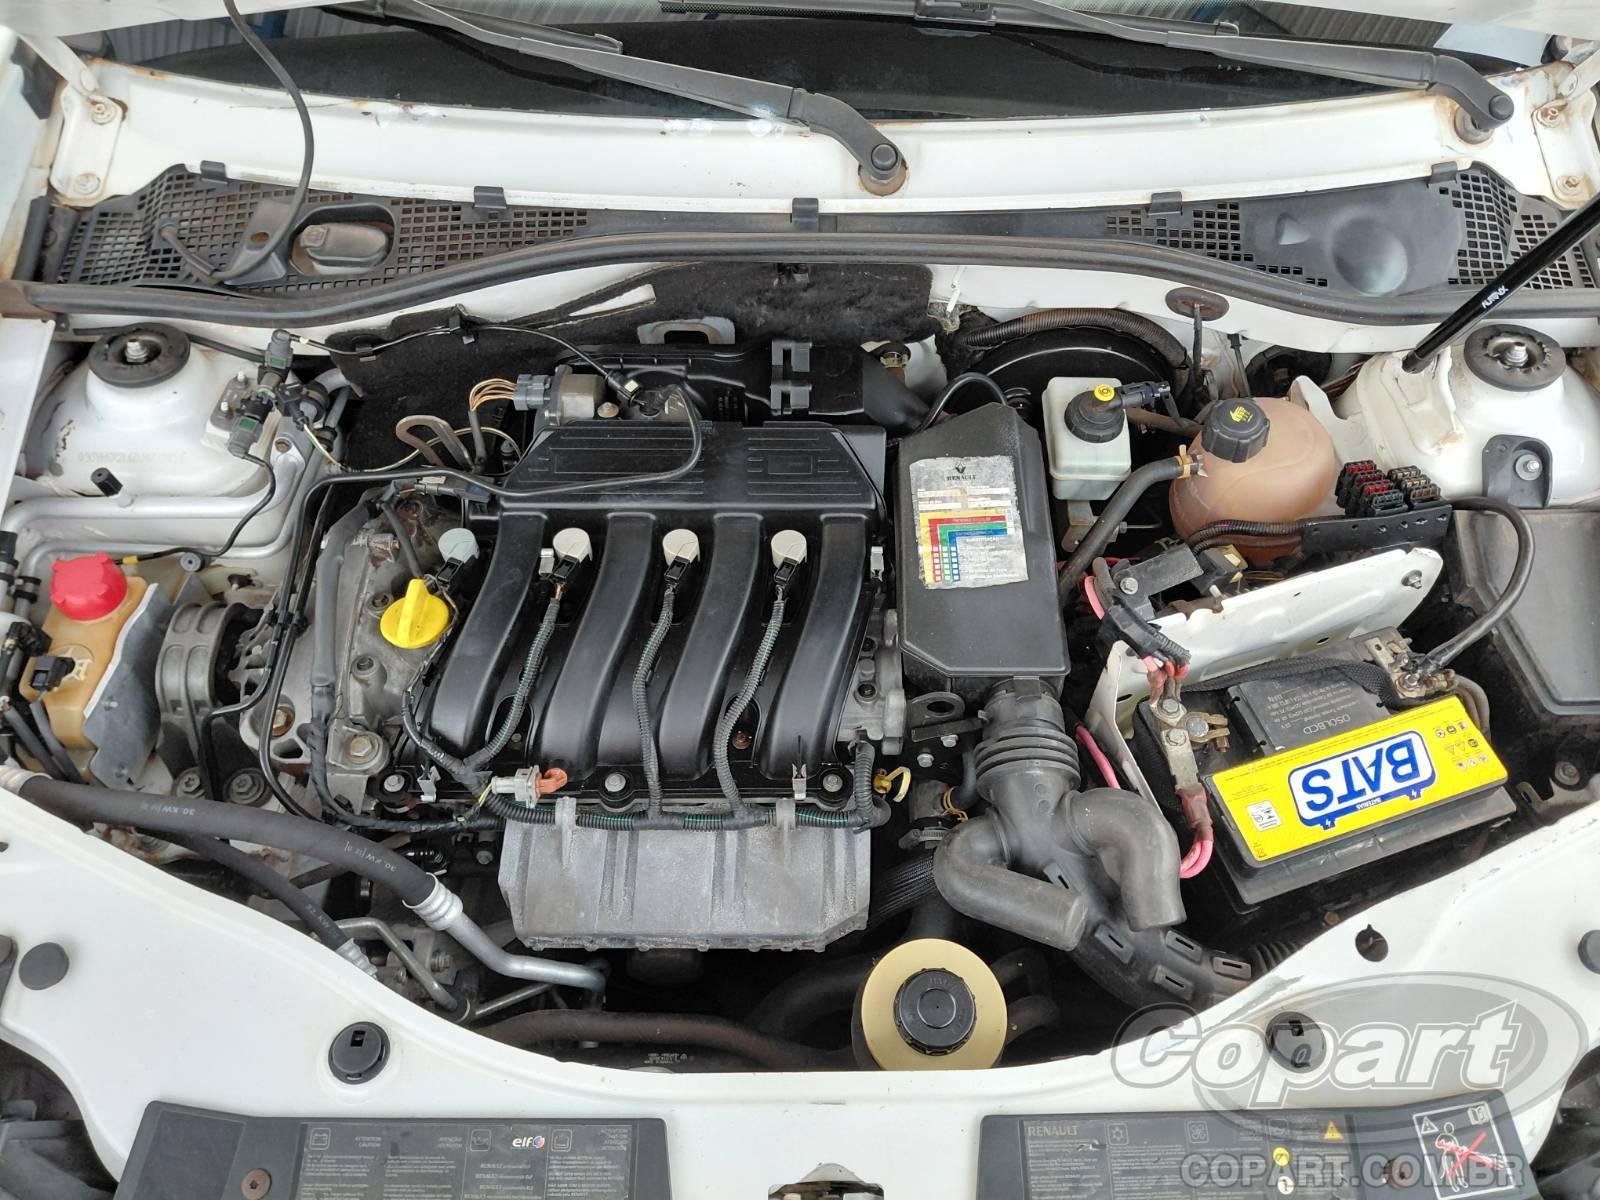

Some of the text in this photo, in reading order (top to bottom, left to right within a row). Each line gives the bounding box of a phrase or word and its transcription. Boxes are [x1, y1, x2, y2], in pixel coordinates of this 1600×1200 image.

[1301, 738, 1421, 812] BATS
[1027, 1125, 1078, 1137] RENAULT
[511, 1136, 533, 1148] elf
